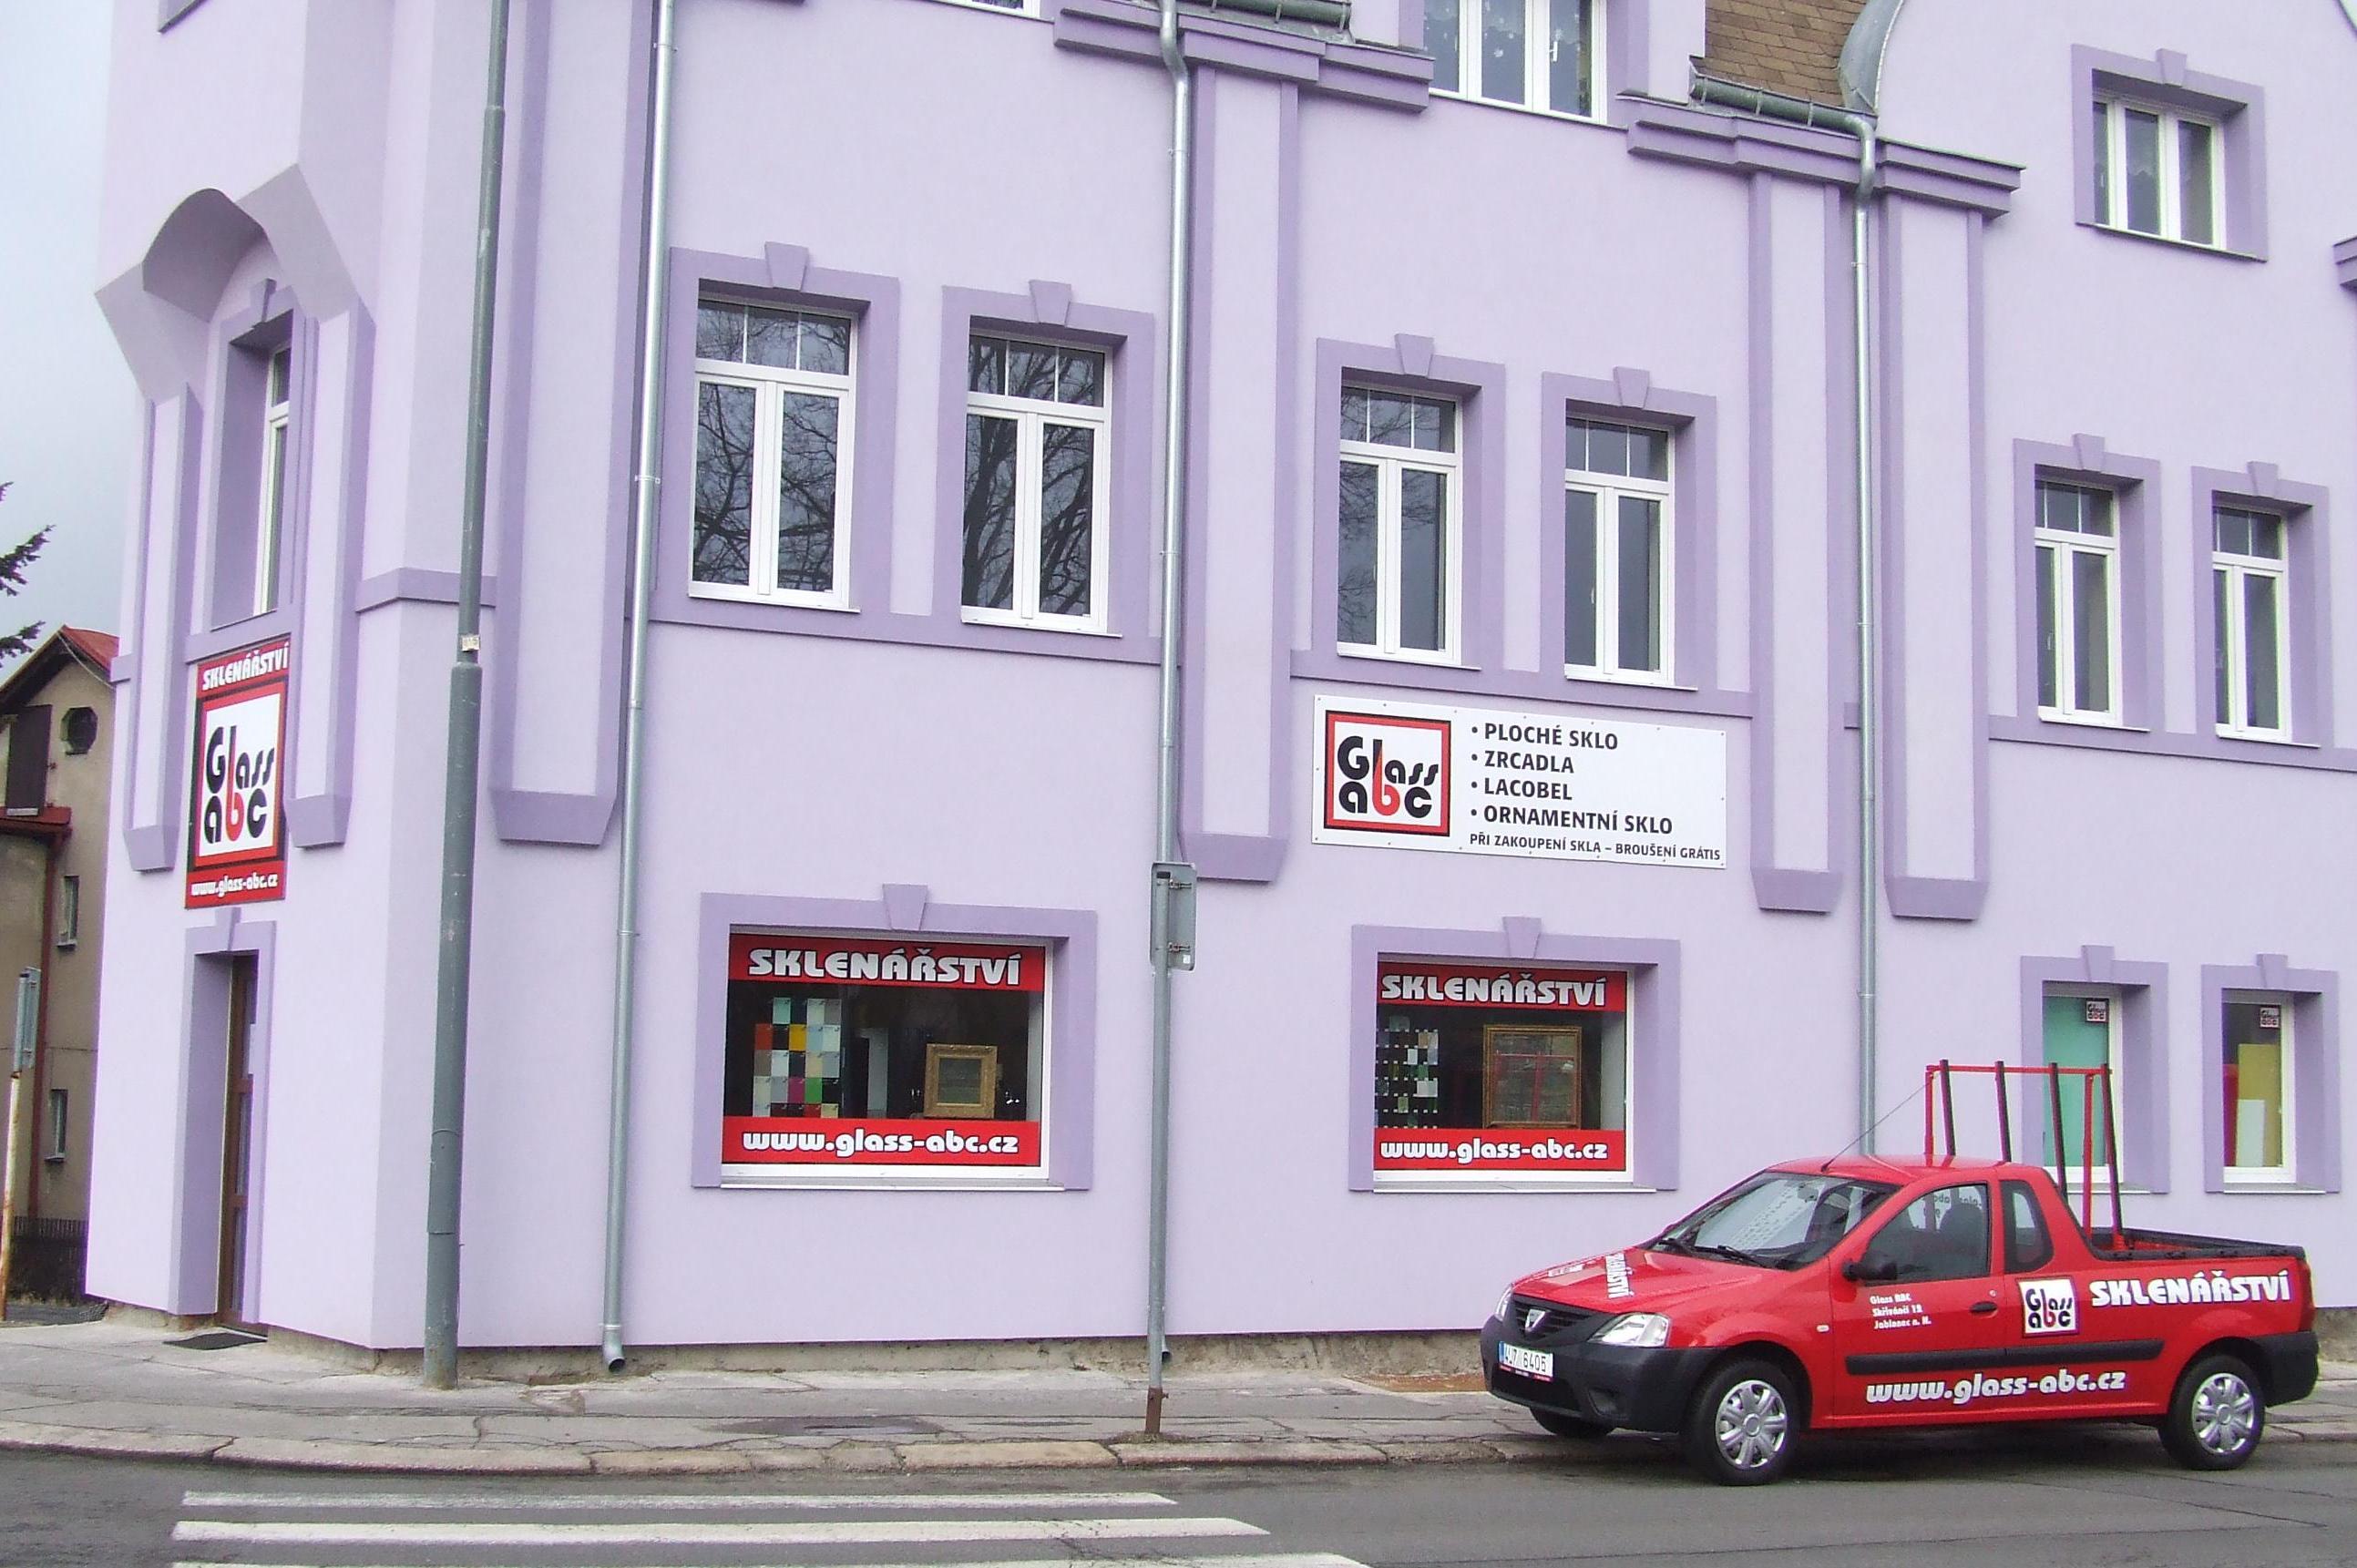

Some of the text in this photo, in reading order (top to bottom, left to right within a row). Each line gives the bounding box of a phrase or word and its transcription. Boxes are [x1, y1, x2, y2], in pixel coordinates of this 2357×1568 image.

[201, 642, 289, 691] SKLENÁŘSTVÍ
[1484, 723, 1618, 750] PLOCHÉ SKLO
[206, 725, 274, 794] Glass
[1337, 735, 1439, 786] Glass
[1484, 750, 1574, 774] ZRCADLA
[1338, 774, 1432, 818] abc
[1484, 777, 1573, 800] LACOBEL
[204, 781, 267, 844] abc
[1483, 805, 1673, 835] ORNAMENTNÍ SKLO
[1470, 832, 1491, 845] PŘI
[1494, 835, 1566, 850] ZAKOUPENÍ
[1570, 839, 1602, 853] SKLA
[1615, 843, 1676, 858] BROUŠENÍ
[1680, 846, 1721, 860] GRÁTIS
[191, 872, 278, 897] www.glass-abc.cz
[748, 948, 1022, 986] SKLENÁŘSTVÍ
[1381, 972, 1607, 1007] SKLENÁŘSTVÍ
[742, 1129, 1019, 1157] www.glass-abc.cz
[1380, 1138, 1608, 1163] www.glass-abc.cz
[1870, 1296, 1892, 1305] Glass
[2025, 1287, 2073, 1311] Glass
[2088, 1269, 2290, 1307] SKLENÁŘSTVÍ
[1874, 1318, 1911, 1329] Jablonec
[2028, 1307, 2071, 1328] abc
[1866, 1369, 2126, 1404] www.glass-abc.cz
